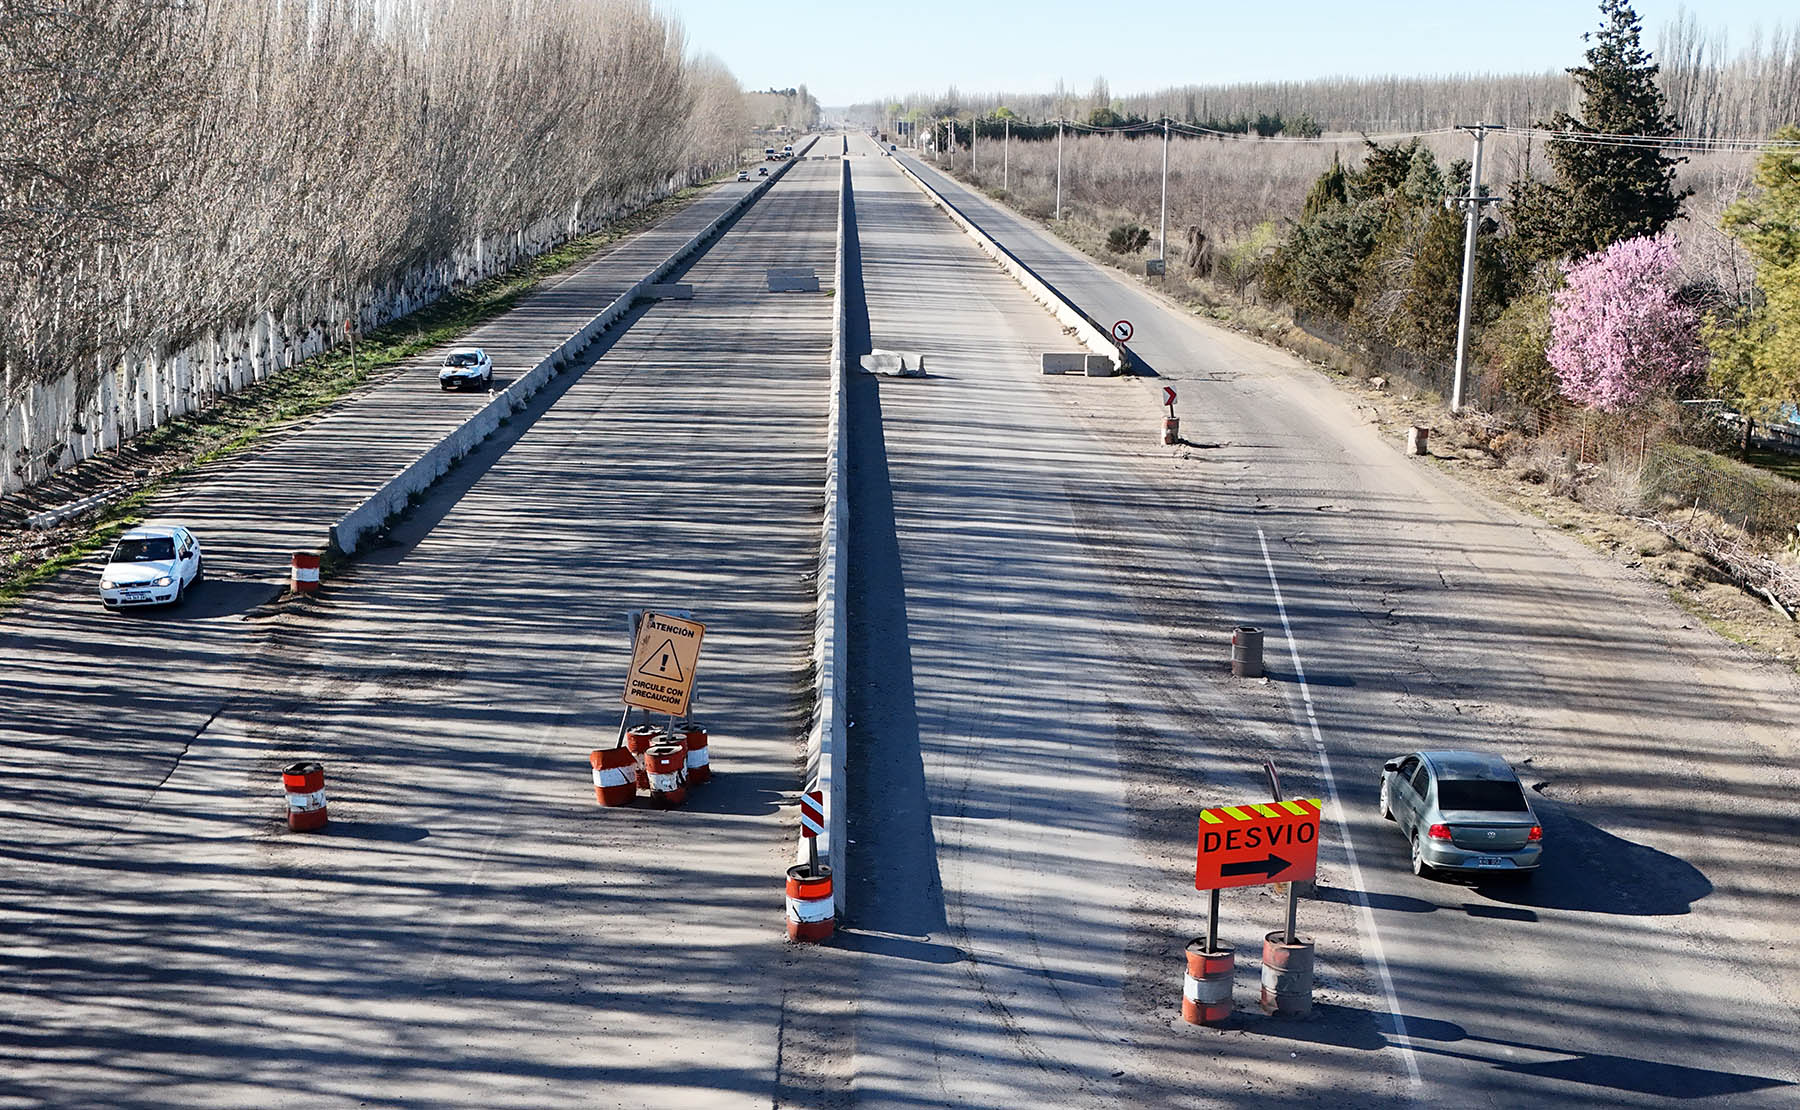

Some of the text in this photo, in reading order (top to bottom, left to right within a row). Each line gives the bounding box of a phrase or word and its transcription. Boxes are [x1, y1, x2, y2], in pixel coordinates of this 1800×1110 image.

[650, 622, 695, 638] ATENCIÓN
[632, 679, 683, 697] CIRCULE CON
[631, 689, 681, 705] PRECAUCIÓN
[1203, 822, 1315, 853] DESVIO
